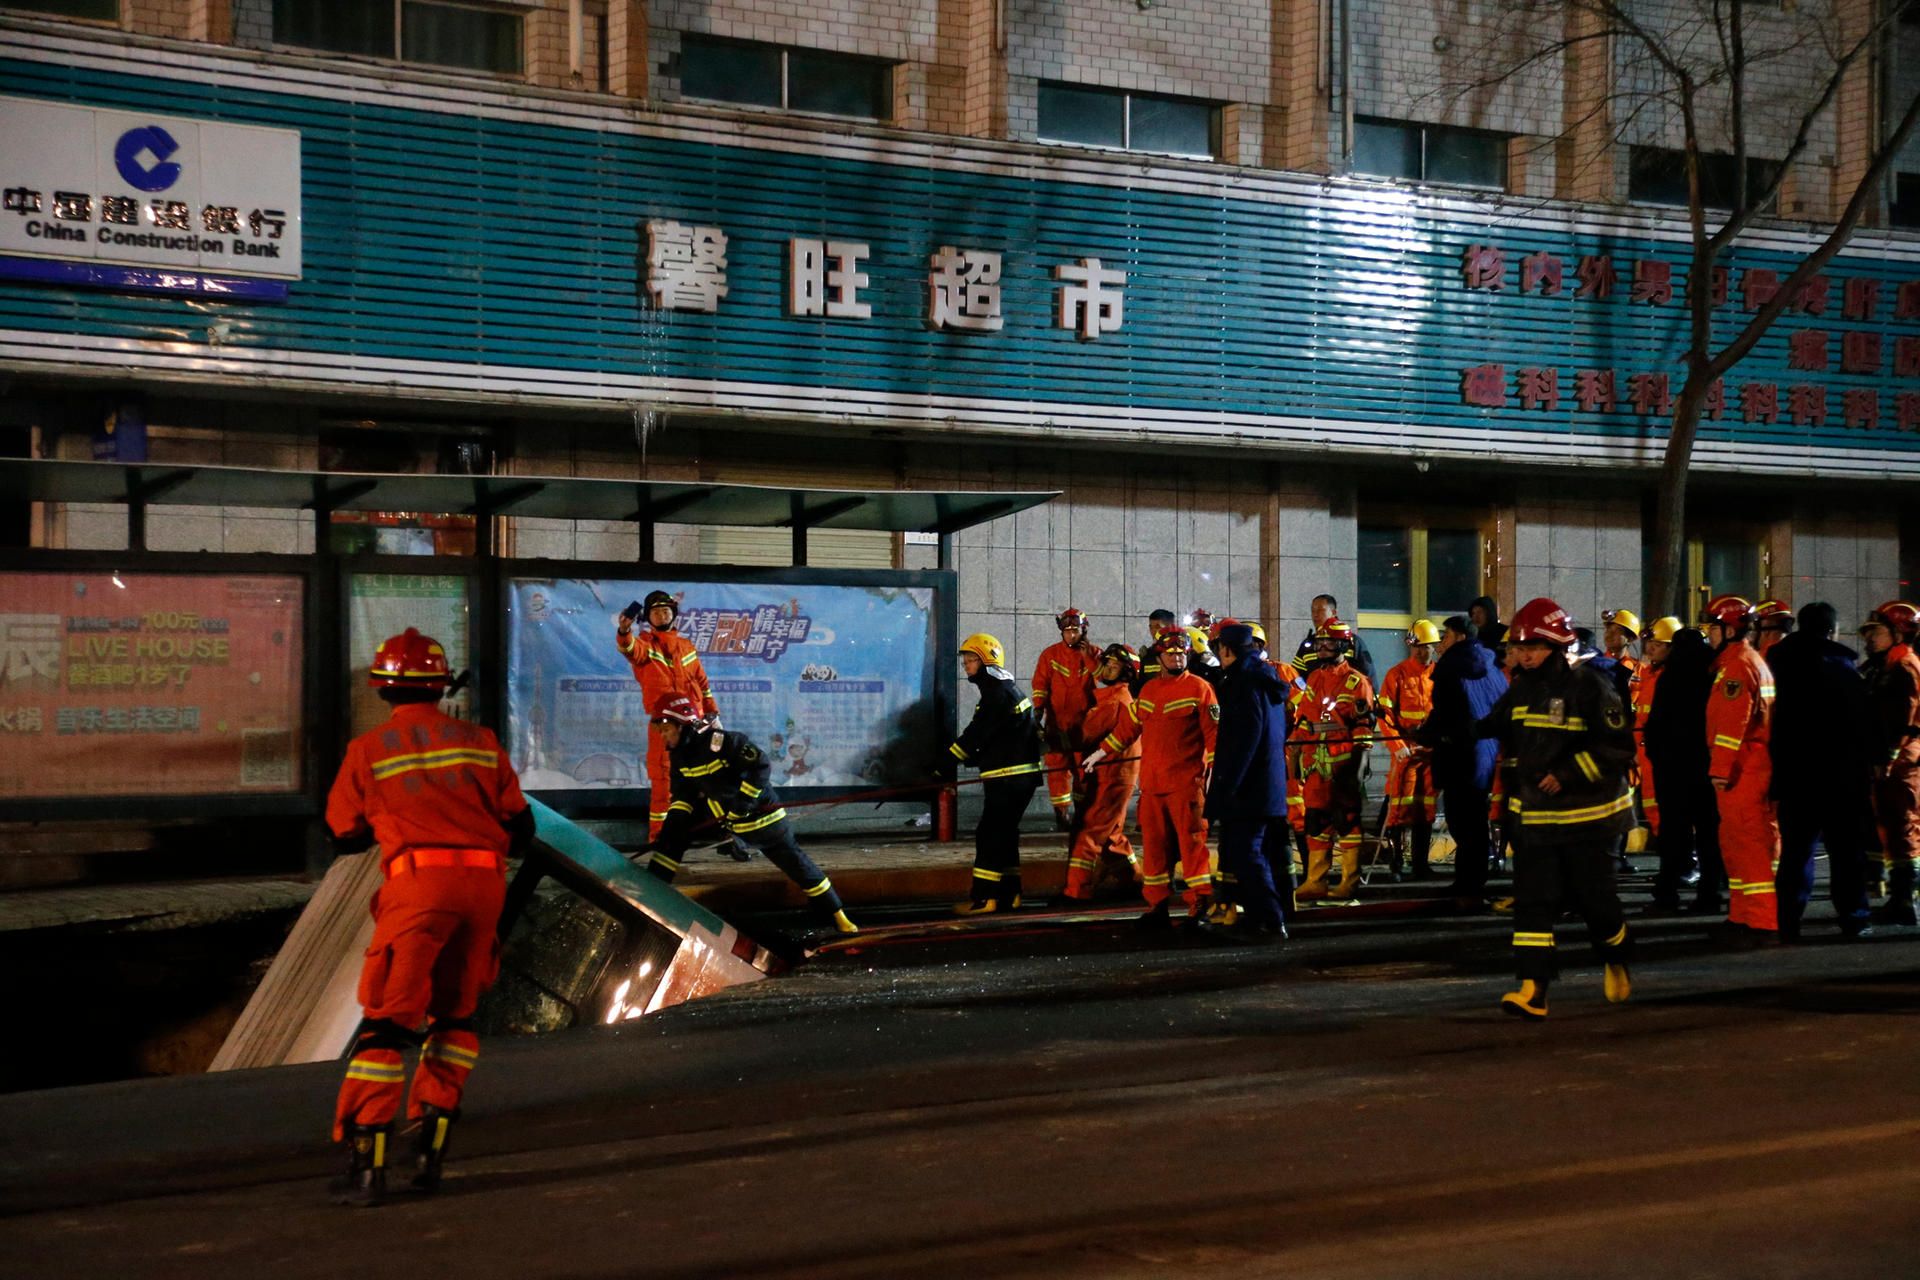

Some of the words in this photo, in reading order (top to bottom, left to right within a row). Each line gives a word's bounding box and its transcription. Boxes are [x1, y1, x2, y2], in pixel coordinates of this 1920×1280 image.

[3, 187, 286, 239] 中国建设银行
[26, 220, 86, 243] China
[98, 227, 223, 254] Construction
[233, 239, 280, 259] Bank
[645, 218, 1127, 342] 馨旺超市
[68, 637, 129, 658] LIVE
[136, 637, 229, 658] HOUSE
